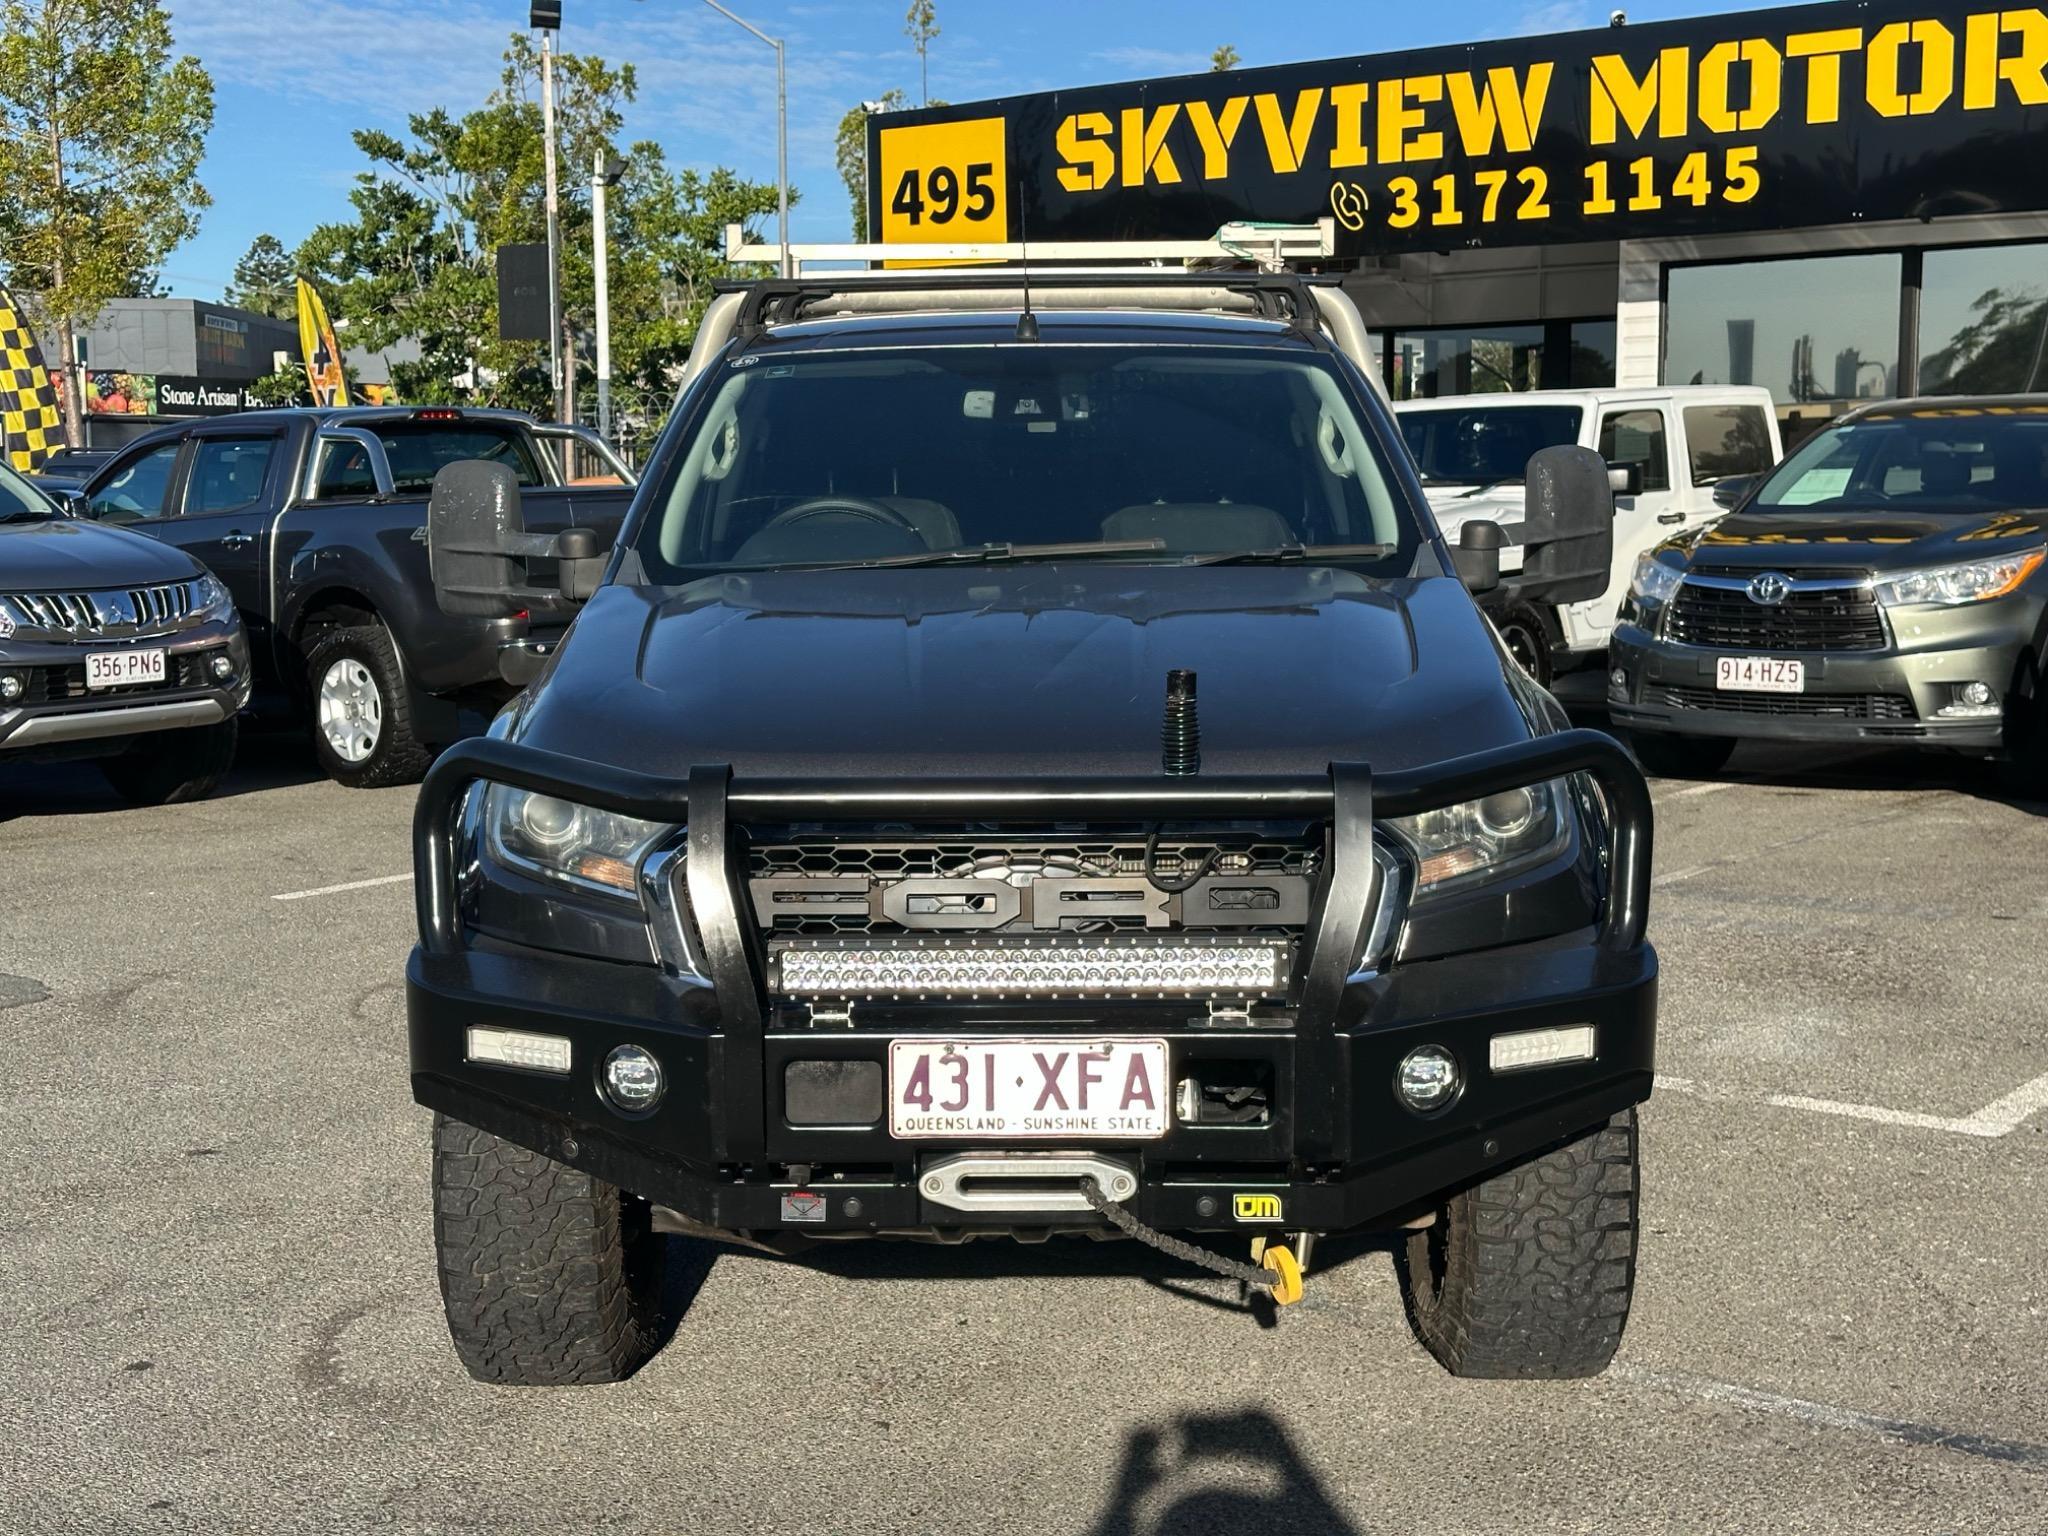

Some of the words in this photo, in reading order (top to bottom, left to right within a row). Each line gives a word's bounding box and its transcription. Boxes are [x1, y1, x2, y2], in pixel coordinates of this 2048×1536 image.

[1056, 61, 1554, 193] SKYVIEW
[1591, 8, 2048, 146] MOTOR
[891, 162, 996, 227] 495
[1386, 166, 1550, 229] 3172
[1582, 146, 1761, 216] 1145
[161, 384, 195, 406] Stone
[906, 1117, 1006, 1130] QUEENSLAND
[1024, 1117, 1099, 1130] SUNSHINE
[1108, 1117, 1153, 1130] STATE
